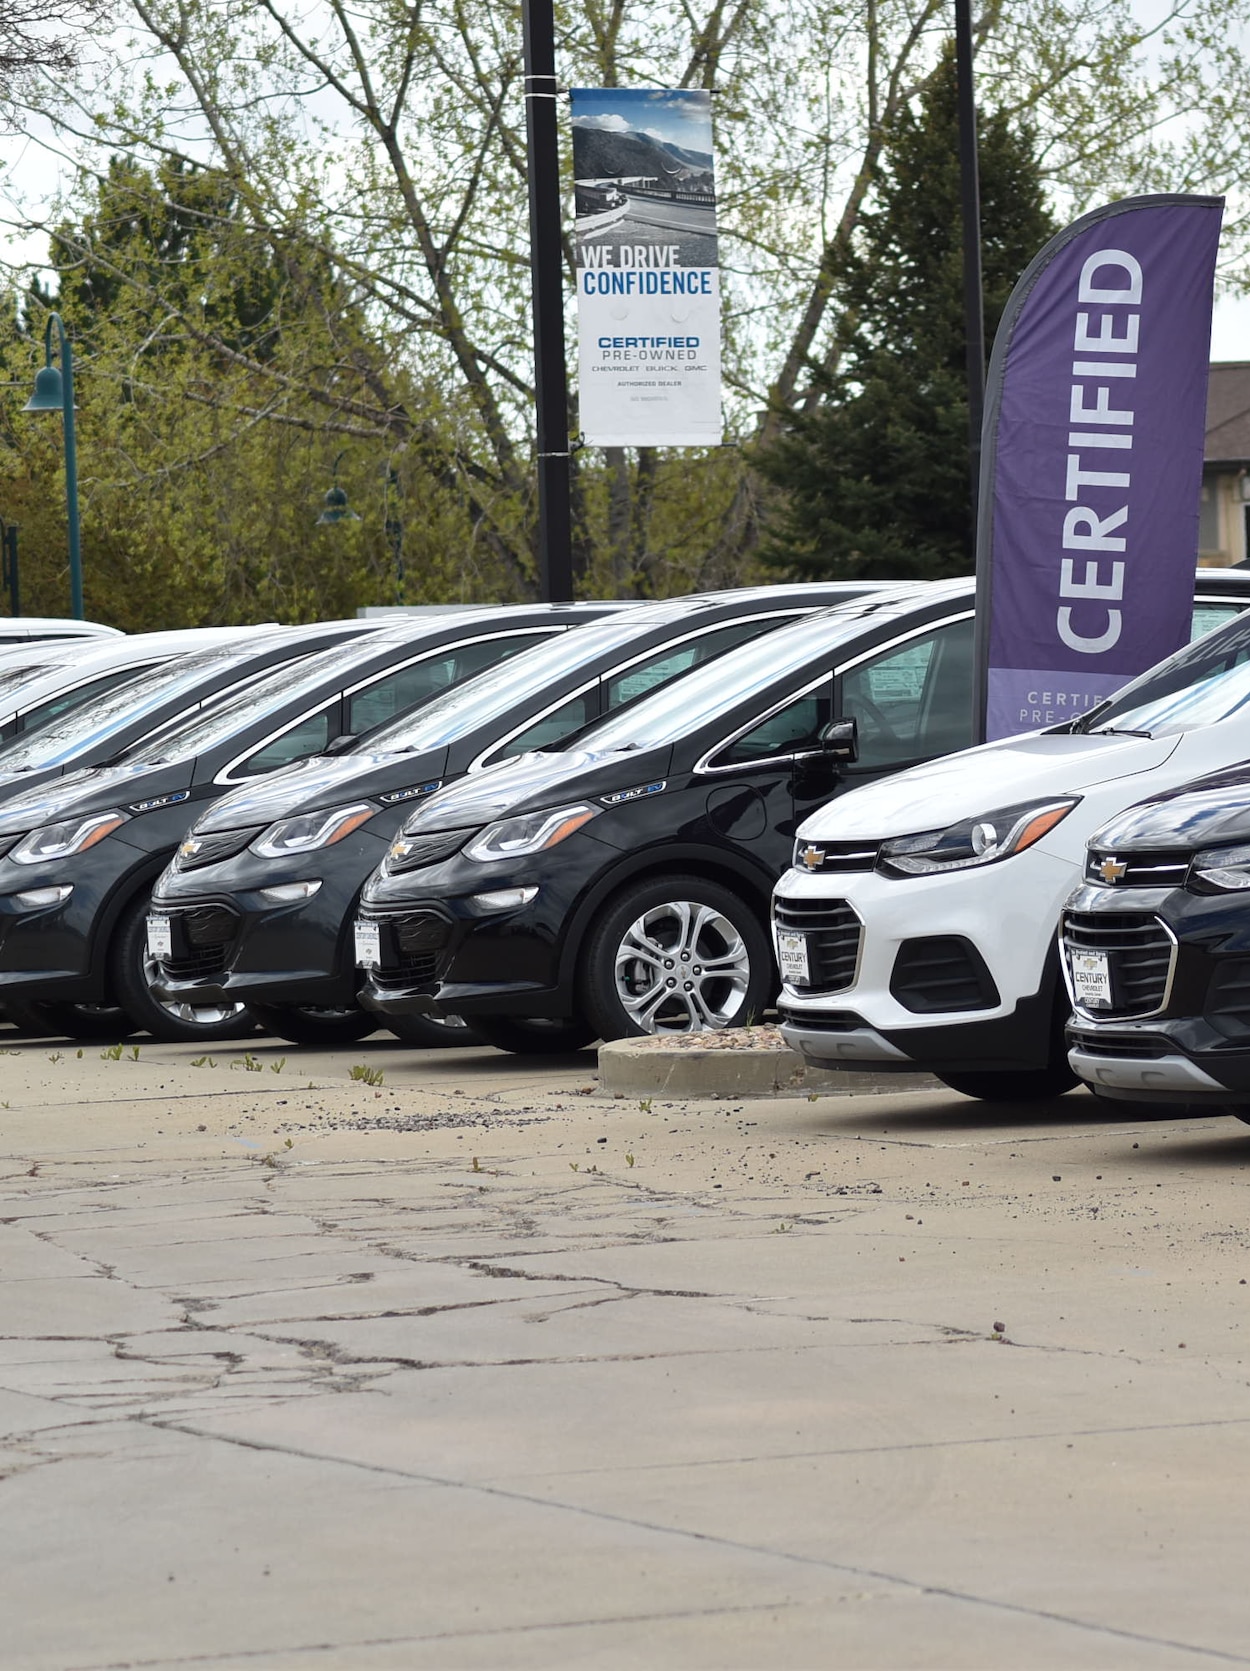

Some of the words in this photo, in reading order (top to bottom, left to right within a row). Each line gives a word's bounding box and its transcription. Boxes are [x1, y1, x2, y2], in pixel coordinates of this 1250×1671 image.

[581, 245, 614, 268] WE
[620, 244, 681, 268] DRIVE
[583, 271, 713, 296] CONFIDENCE
[598, 336, 700, 348] CERTIFIED
[602, 350, 697, 361] PRE-OWNED
[1056, 248, 1144, 654] CERTIFIED
[1028, 691, 1103, 707] CERTIF
[390, 788, 421, 800] BOLT
[424, 783, 438, 792] EV
[611, 788, 643, 801] BOLT
[647, 783, 662, 792] EV
[139, 797, 169, 809] BOLT
[172, 793, 186, 802] EV
[781, 951, 806, 963] CENTURY
[1075, 972, 1108, 985] CENTURY
